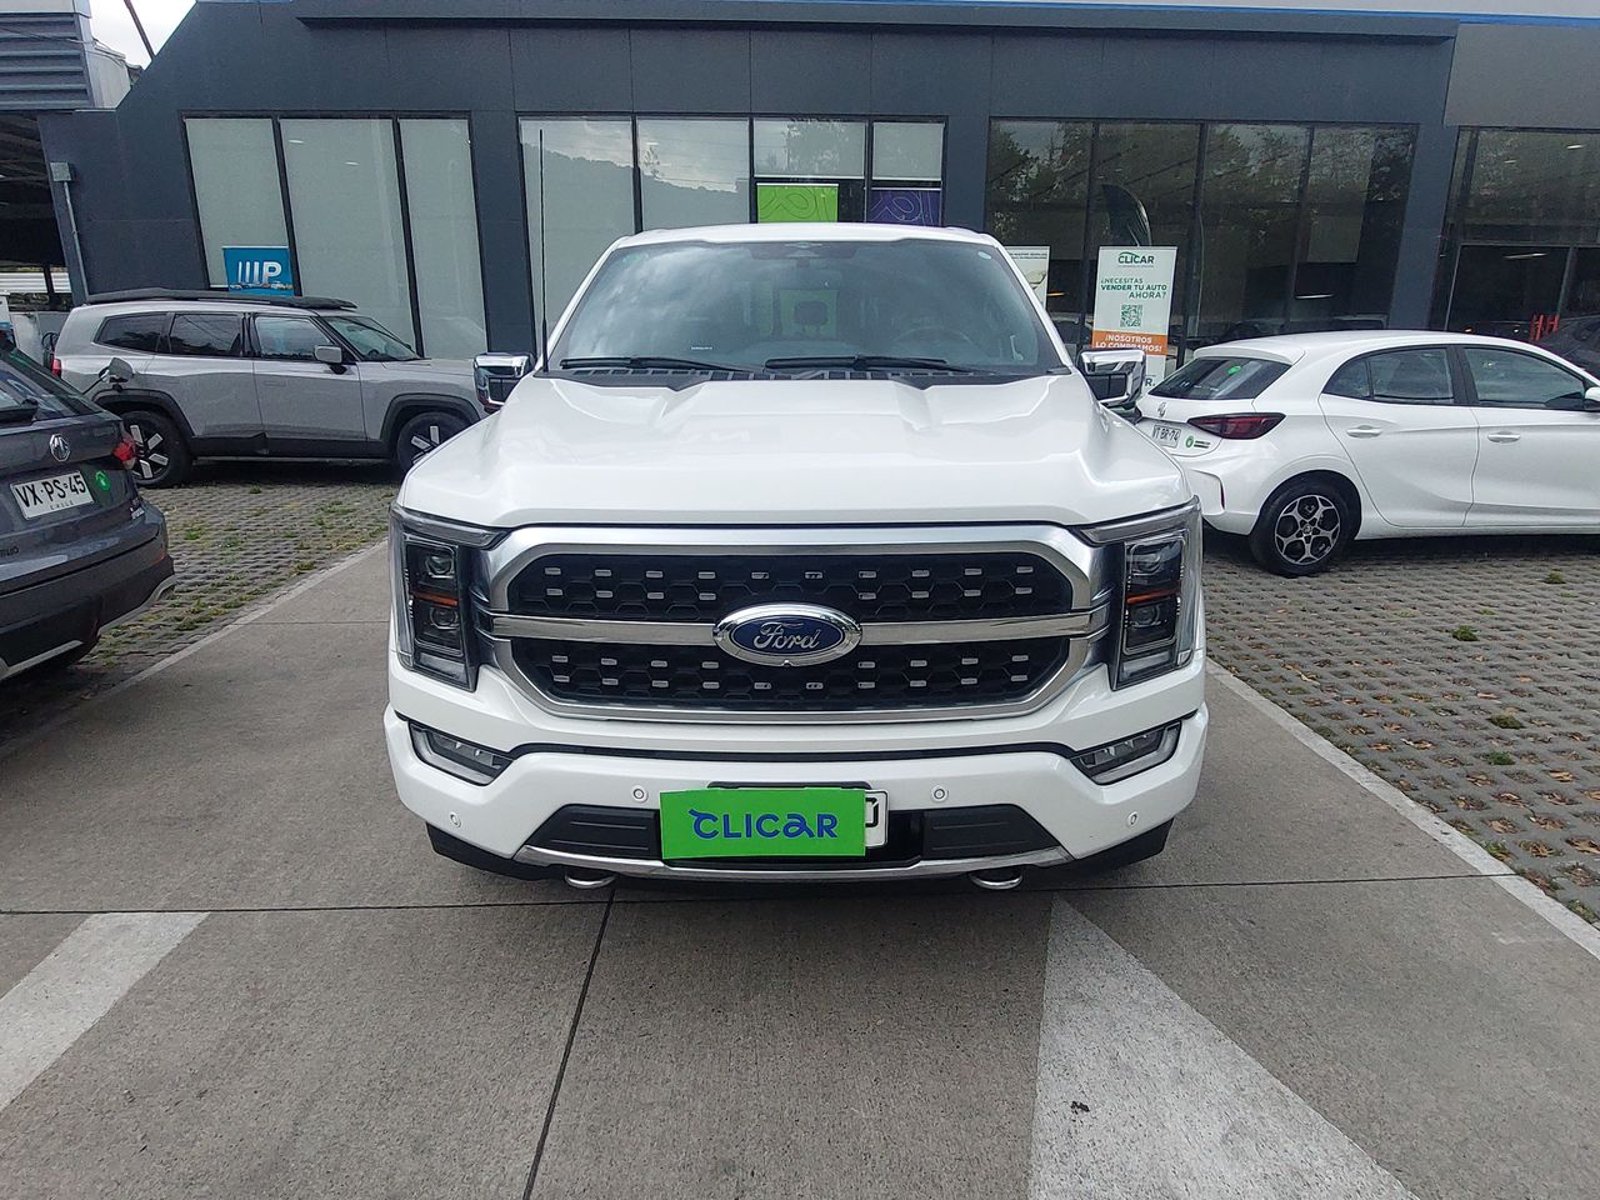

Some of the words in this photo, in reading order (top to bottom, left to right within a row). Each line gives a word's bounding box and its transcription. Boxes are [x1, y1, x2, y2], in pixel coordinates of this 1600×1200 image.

[1118, 252, 1154, 264] CLICAR
[1129, 291, 1167, 299] AHORA?
[753, 621, 821, 649] Ford
